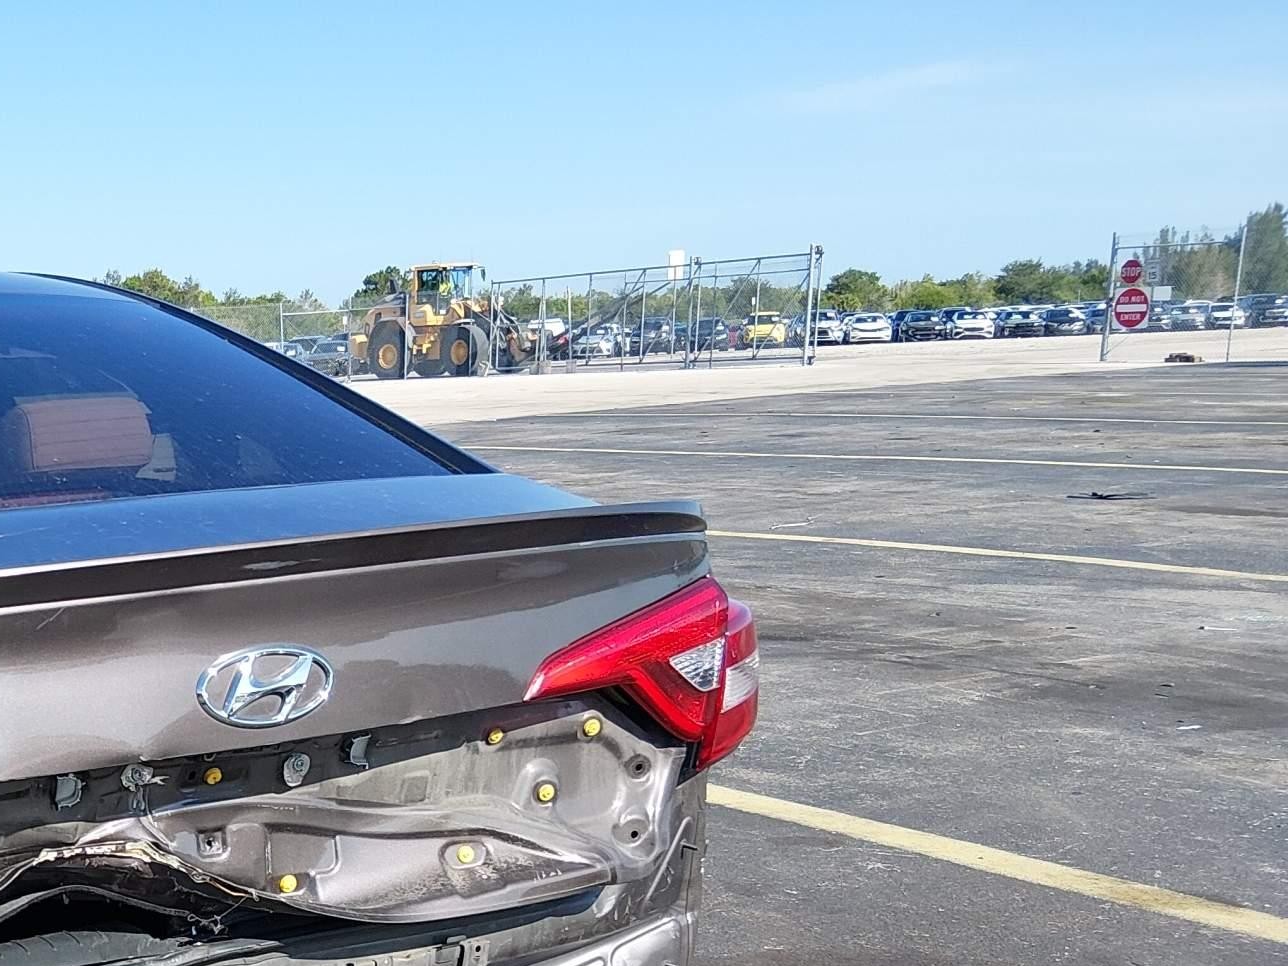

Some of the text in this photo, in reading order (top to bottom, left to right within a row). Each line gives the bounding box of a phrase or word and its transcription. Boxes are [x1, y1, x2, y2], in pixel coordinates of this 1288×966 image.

[1122, 267, 1141, 277] STOP
[1148, 271, 1157, 280] 15
[1131, 295, 1145, 303] NOT
[1120, 313, 1141, 321] ENTER
